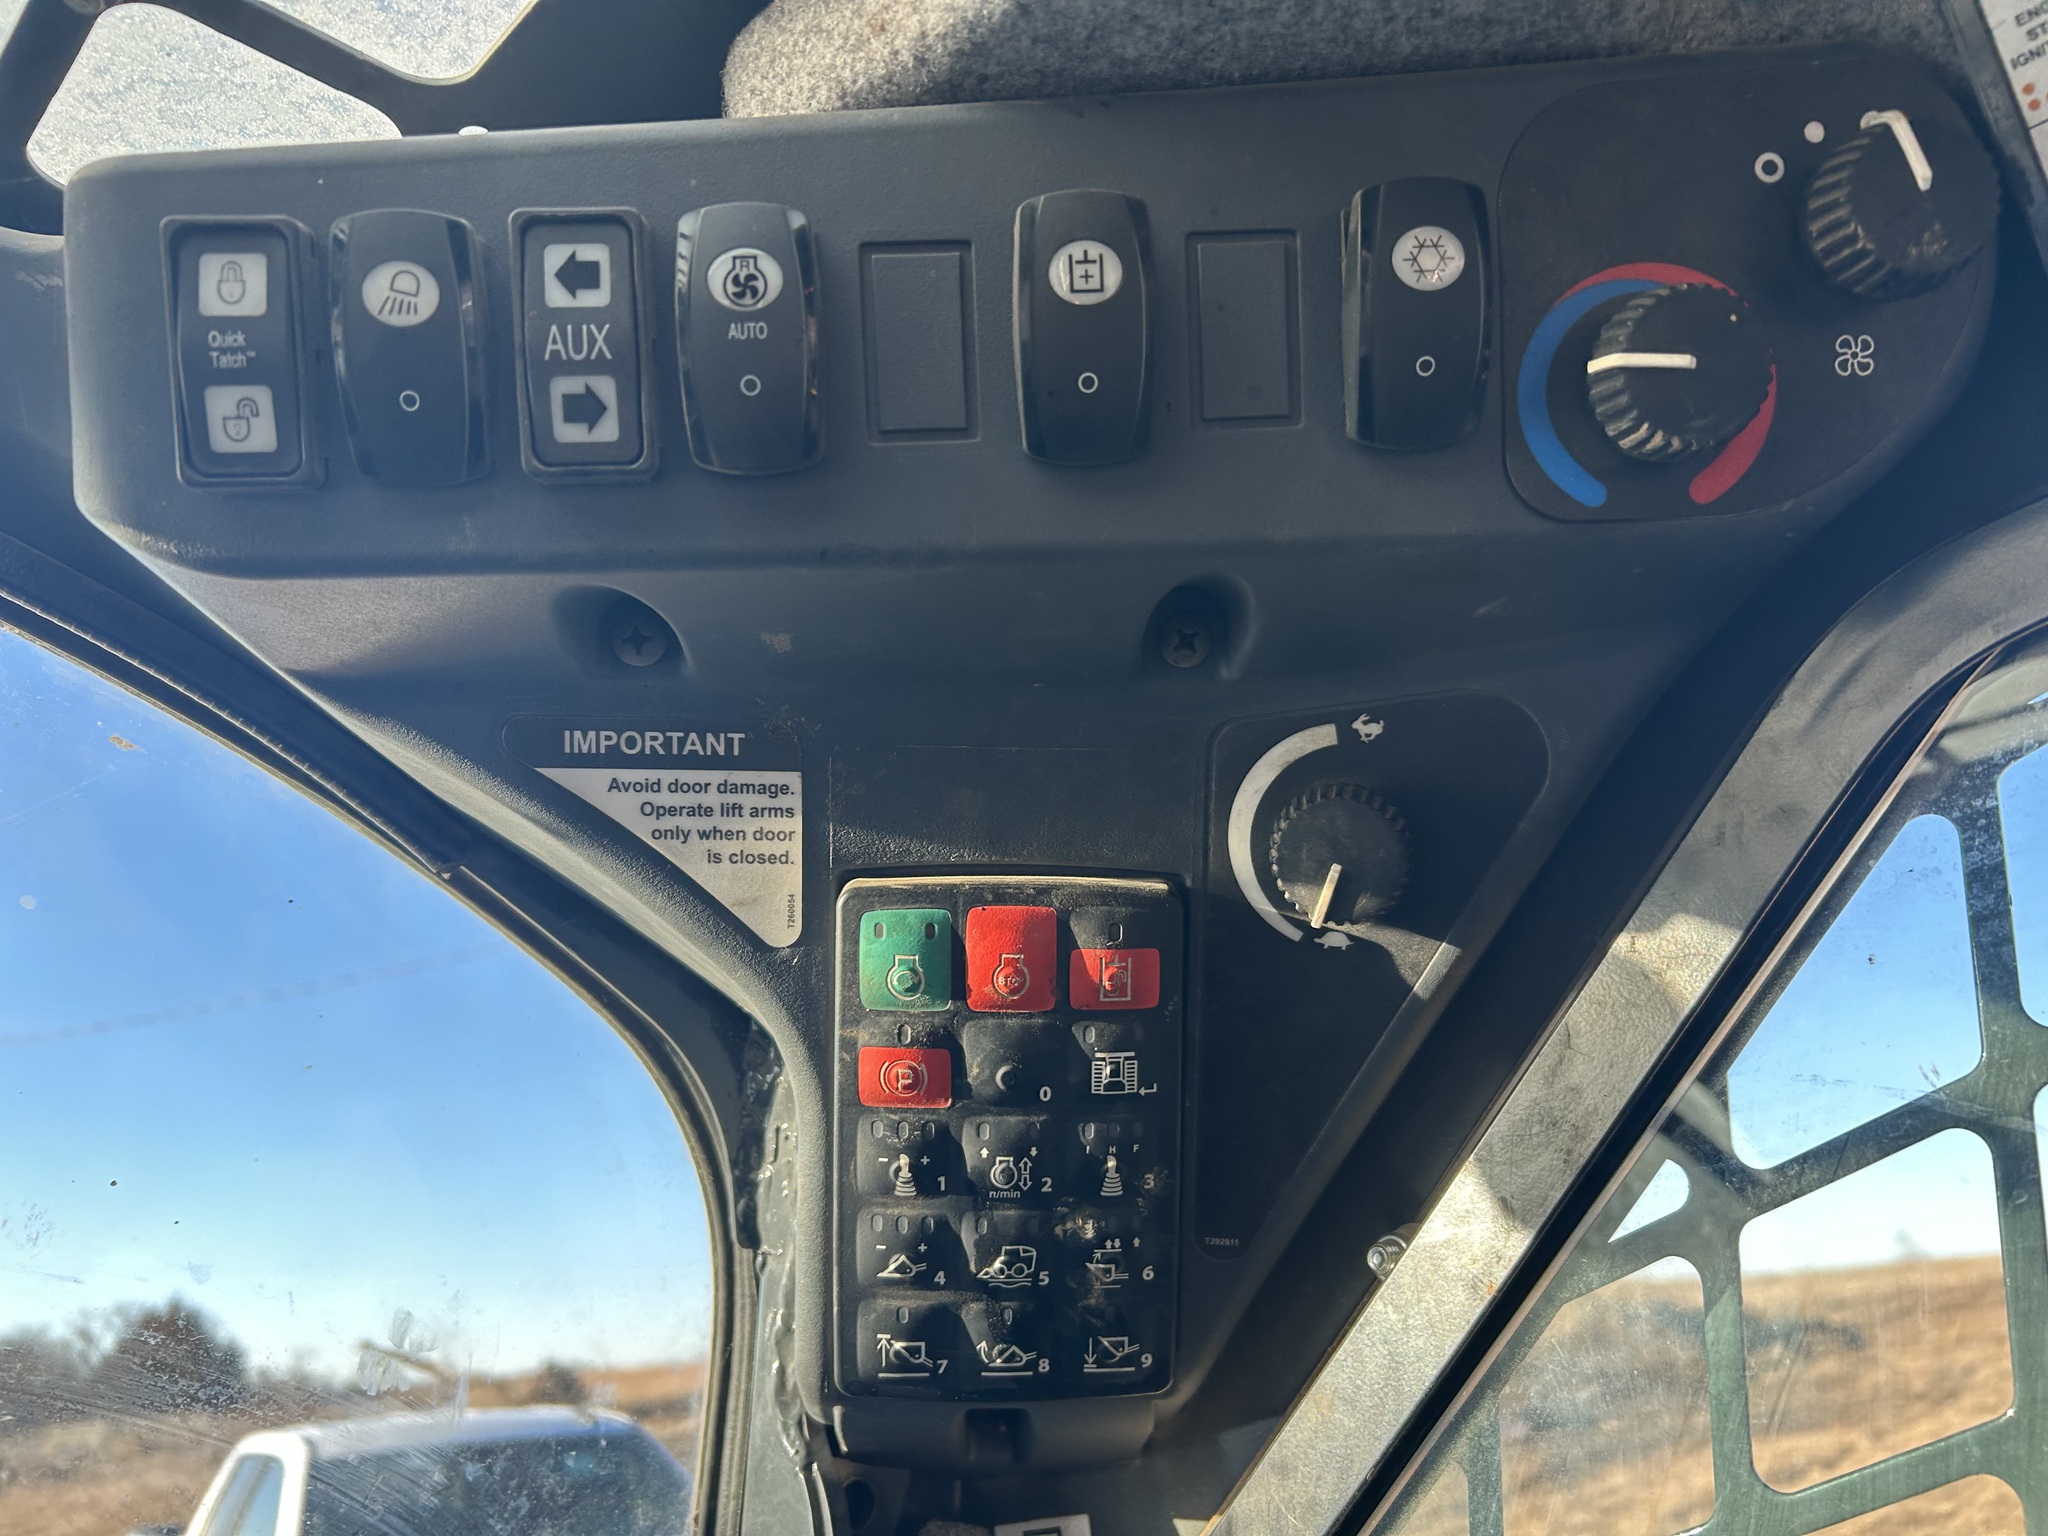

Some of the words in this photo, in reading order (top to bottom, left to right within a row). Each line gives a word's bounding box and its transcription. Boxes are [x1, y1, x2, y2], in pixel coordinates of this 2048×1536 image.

[728, 322, 768, 340] AUTO
[207, 330, 247, 348] Quick
[544, 324, 613, 361] AUX
[564, 730, 746, 756] IMPORTANT
[607, 777, 662, 794] Avoid
[667, 777, 711, 794] door
[716, 778, 796, 799] damage.
[639, 801, 714, 820] Operate
[720, 803, 744, 818] lift
[749, 806, 796, 819] arms
[651, 827, 691, 844] only
[698, 828, 747, 842] when
[752, 829, 796, 843] door
[707, 851, 723, 865] is
[728, 851, 795, 866] closed.
[787, 894, 796, 929] T260054
[1039, 1086, 1051, 1102] 0
[937, 1176, 946, 1191] 1
[1041, 1177, 1053, 1192] 2
[1143, 1173, 1155, 1189] 3
[988, 1189, 1021, 1199] n/min
[933, 1273, 946, 1285] 4
[1038, 1272, 1049, 1285] 5
[1142, 1267, 1154, 1281] 6
[936, 1360, 948, 1374] 7
[1038, 1359, 1050, 1372] 8
[1141, 1354, 1153, 1368] 9
